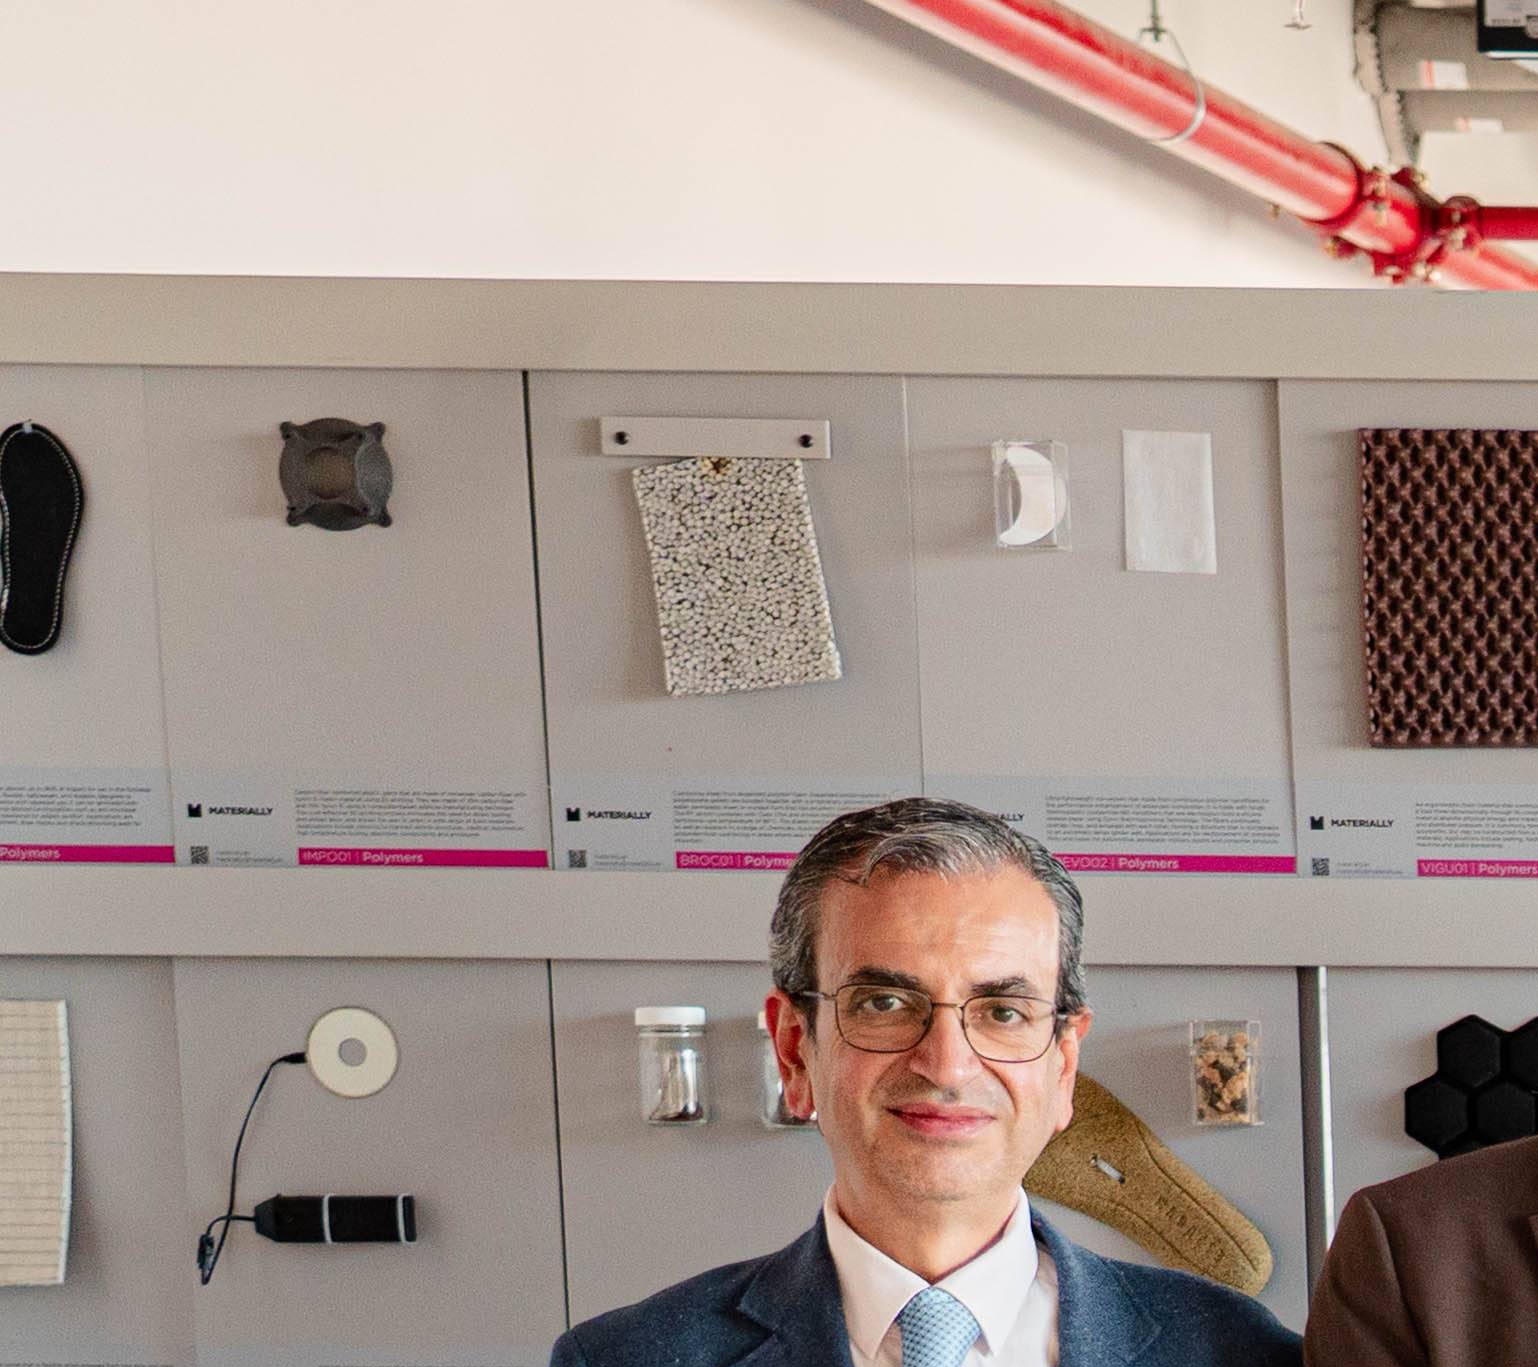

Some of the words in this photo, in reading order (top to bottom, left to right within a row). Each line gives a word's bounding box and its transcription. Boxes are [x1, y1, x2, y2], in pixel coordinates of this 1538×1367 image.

[209, 806, 273, 816] MATERIALLY
[588, 810, 652, 820] MATERIALLY
[1331, 818, 1393, 828] MATERIALLY
[362, 851, 424, 864] Polymers
[1118, 858, 1179, 870] Polymers
[1479, 863, 1538, 876] Polymers
